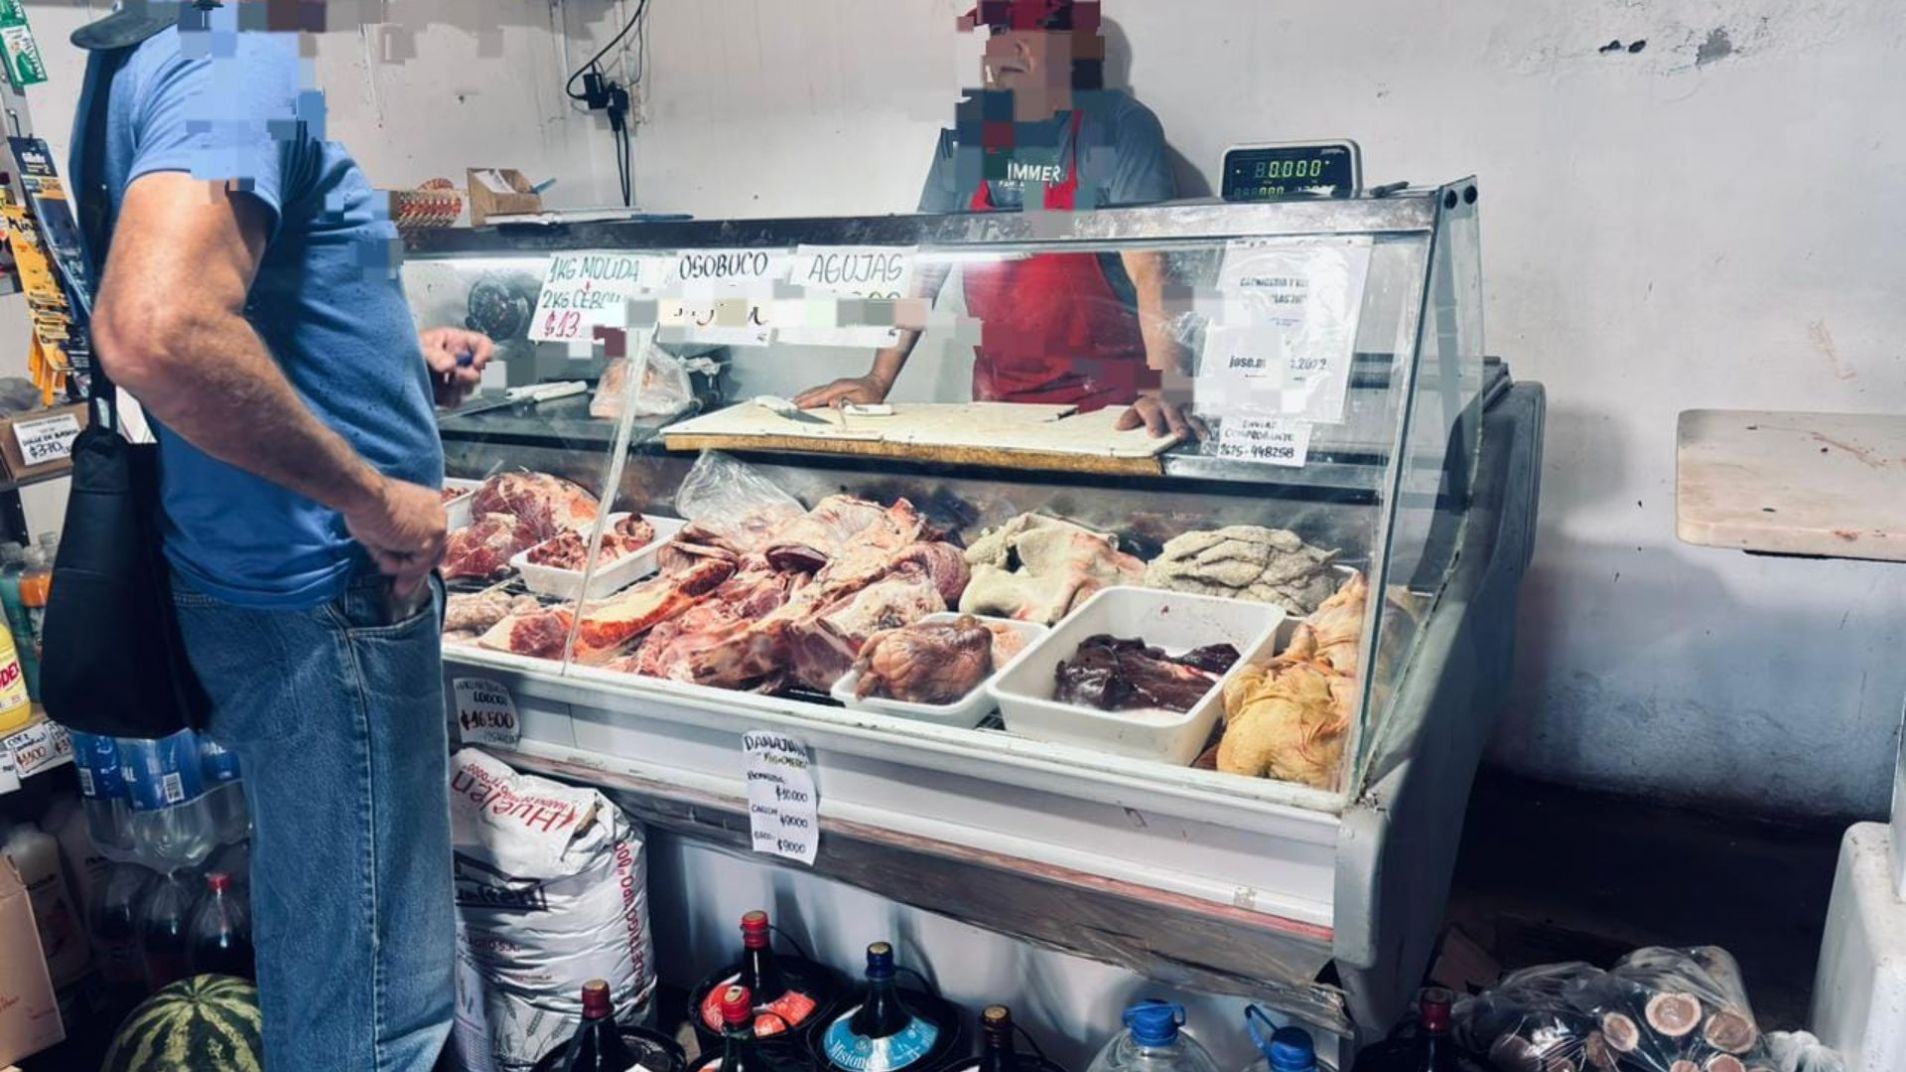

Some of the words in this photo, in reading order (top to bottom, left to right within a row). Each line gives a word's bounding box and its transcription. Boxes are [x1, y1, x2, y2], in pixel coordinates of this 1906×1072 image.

[548, 256, 577, 283] 1KG
[679, 251, 768, 280] OSOBUCO
[808, 253, 903, 284] AGUJAS
[542, 289, 570, 309] 2KG
